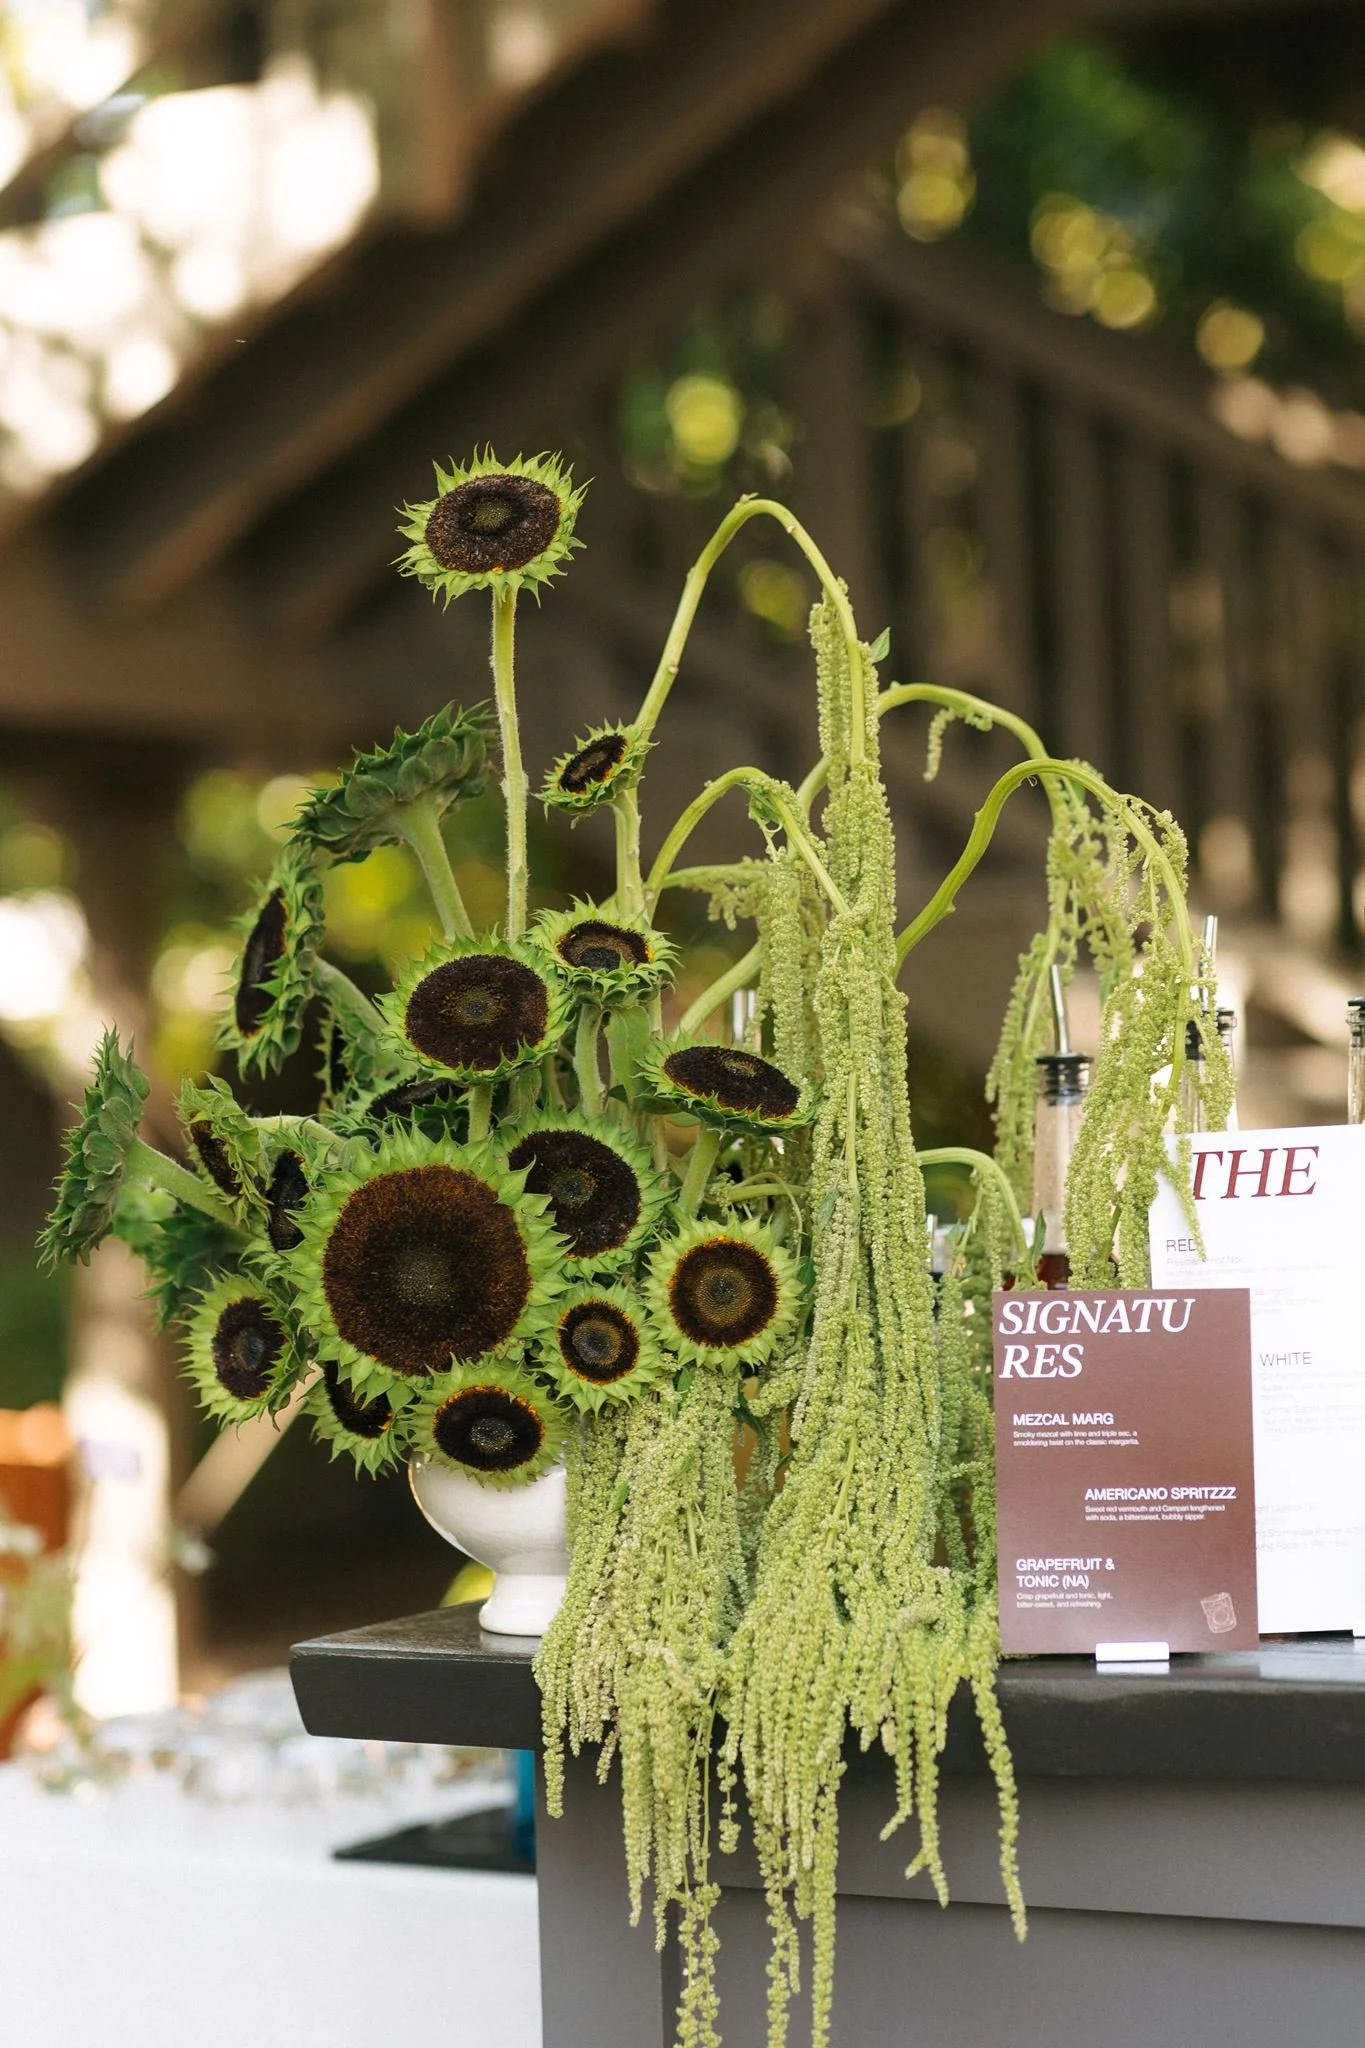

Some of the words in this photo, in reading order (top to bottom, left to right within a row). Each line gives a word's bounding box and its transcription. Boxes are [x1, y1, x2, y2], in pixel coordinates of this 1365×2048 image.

[1192, 1146, 1319, 1200] THE
[999, 1299, 1196, 1334] SIGNATU
[999, 1344, 1084, 1378] RES
[1259, 1351, 1312, 1366] WHITE
[1013, 1413, 1069, 1425] MEZCAL
[1072, 1412, 1114, 1425] MARG
[1085, 1487, 1168, 1500] AMERICANO
[1171, 1486, 1237, 1499] SPRITZZZ
[1016, 1558, 1102, 1571] GRAPEFRUIT
[1105, 1558, 1115, 1570] &
[1016, 1575, 1059, 1587] TONIC
[1062, 1575, 1089, 1589] (NA)
